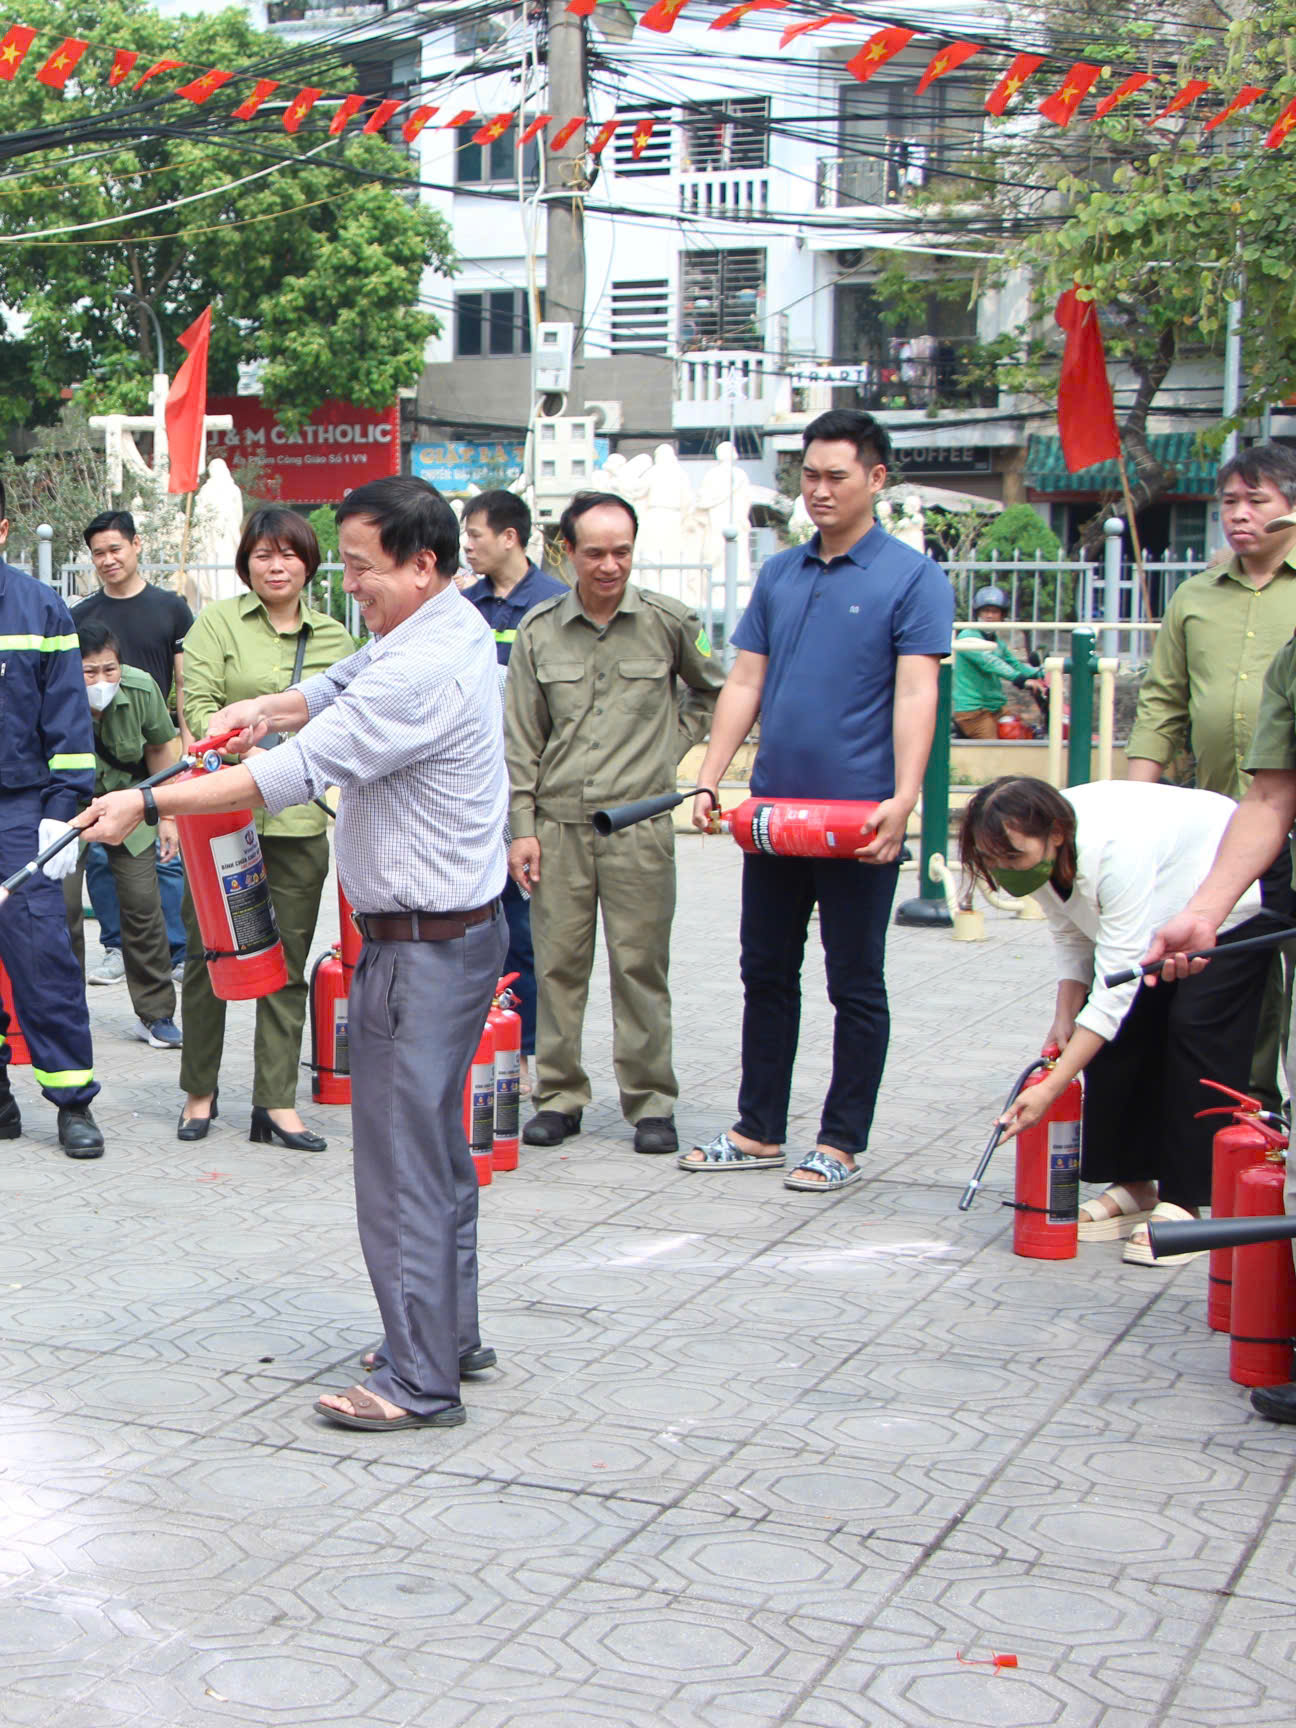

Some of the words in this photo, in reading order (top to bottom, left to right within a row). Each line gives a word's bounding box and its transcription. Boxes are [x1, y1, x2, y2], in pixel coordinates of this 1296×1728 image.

[224, 427, 241, 444] &
[245, 427, 266, 444] M
[271, 423, 392, 444] CATHOLIC
[276, 453, 303, 466] Công
[328, 451, 342, 464] Số
[344, 453, 350, 463] 1
[352, 453, 368, 463] VN
[899, 447, 974, 462] COFFEE
